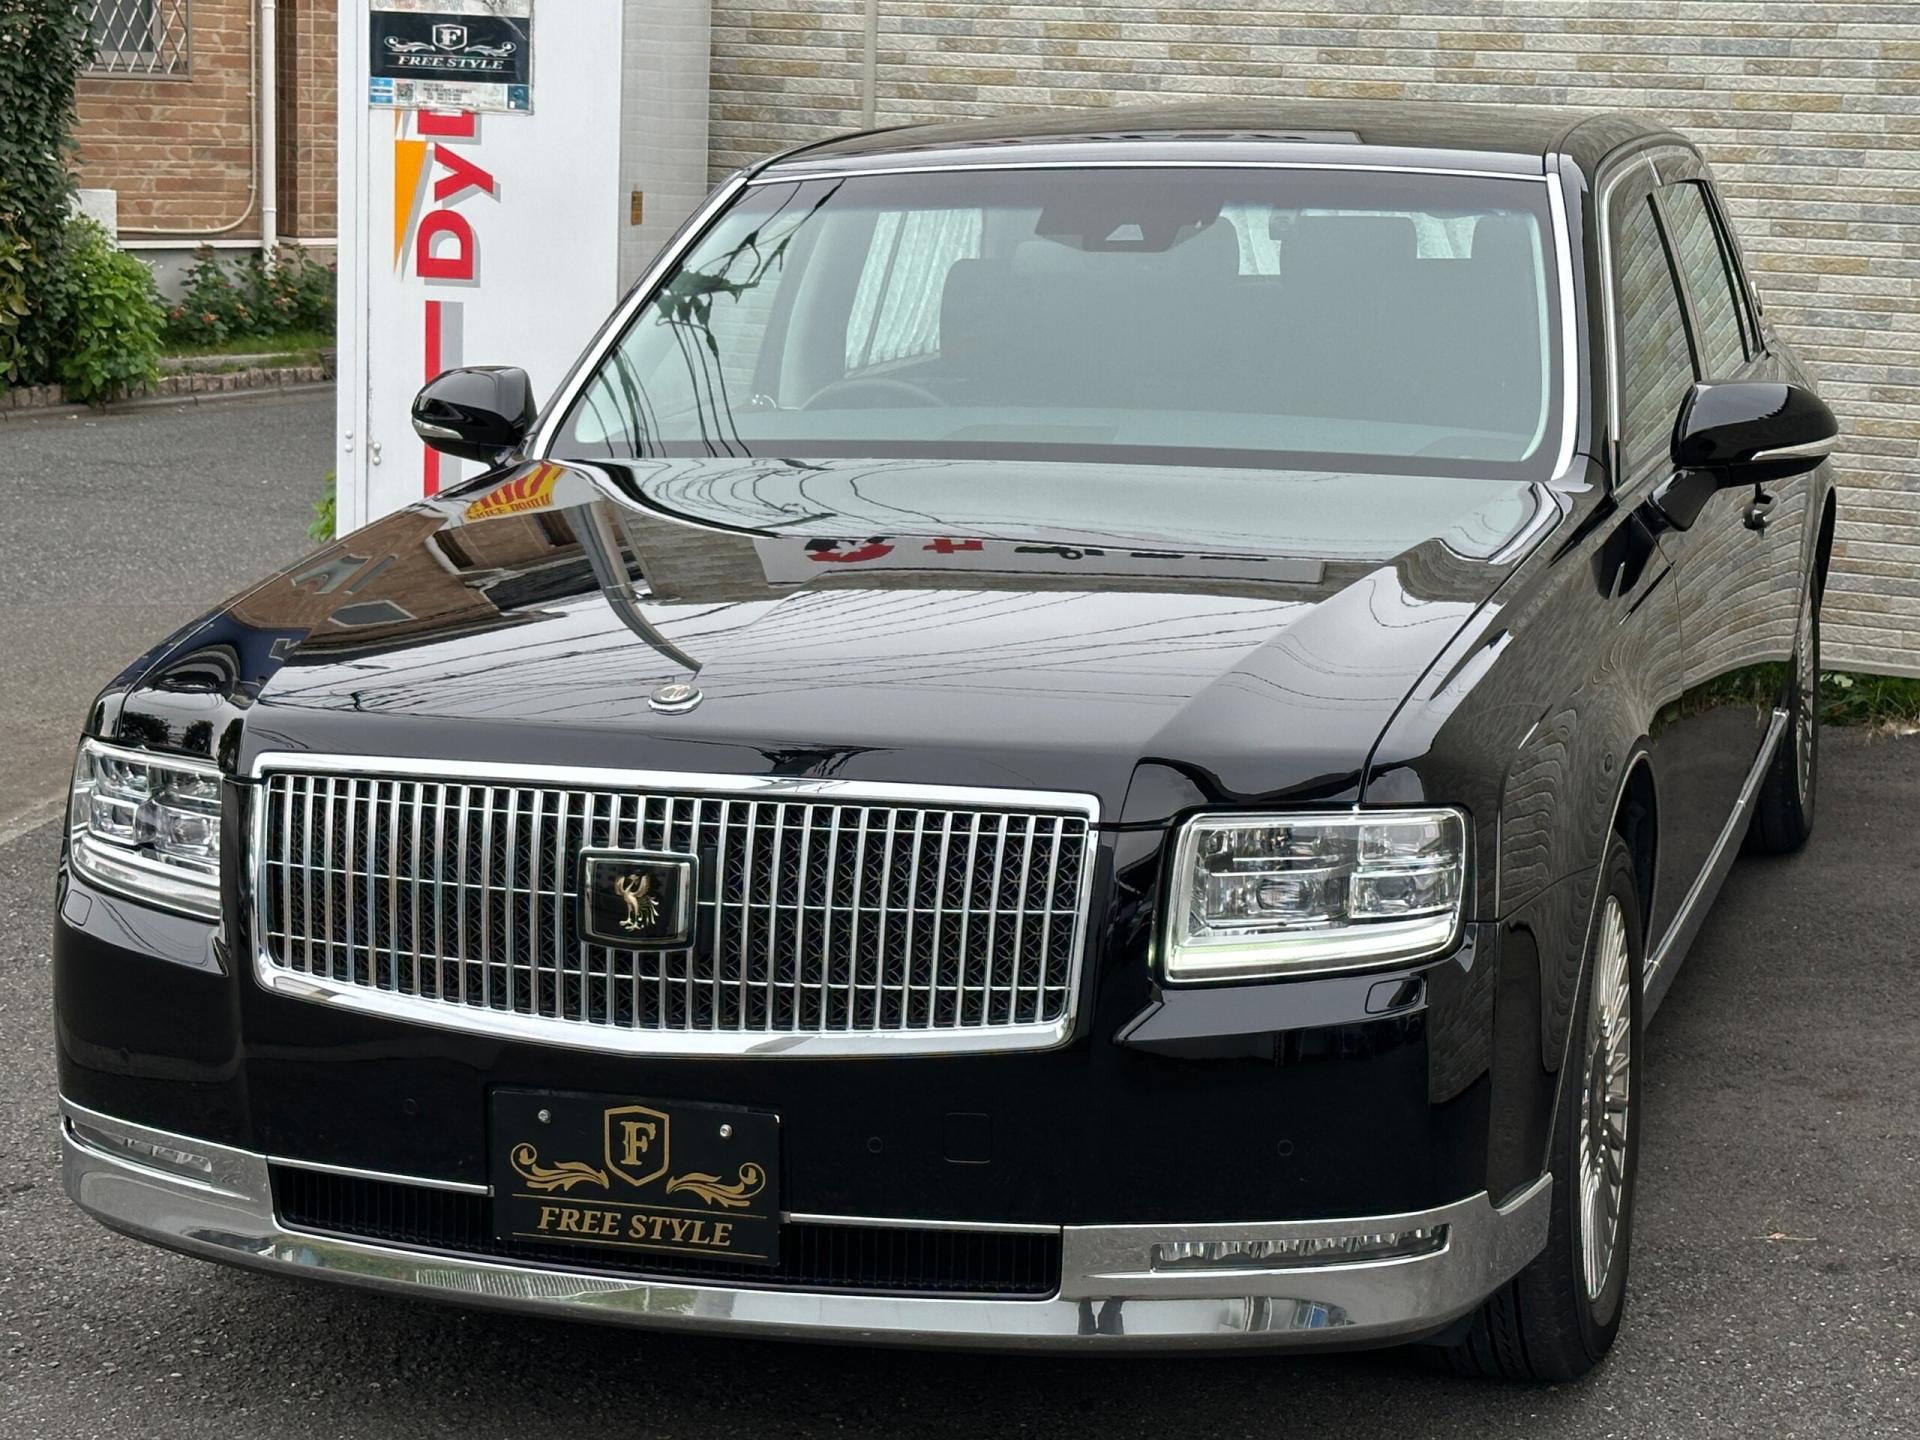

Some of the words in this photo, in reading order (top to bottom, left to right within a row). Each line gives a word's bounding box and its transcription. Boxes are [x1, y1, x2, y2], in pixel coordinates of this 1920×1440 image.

[439, 28, 462, 46] F
[398, 55, 444, 67] FREE
[446, 58, 505, 70] STYLE
[619, 1121, 656, 1166] F
[537, 1206, 621, 1236] FREE
[628, 1214, 733, 1247] STYLE
